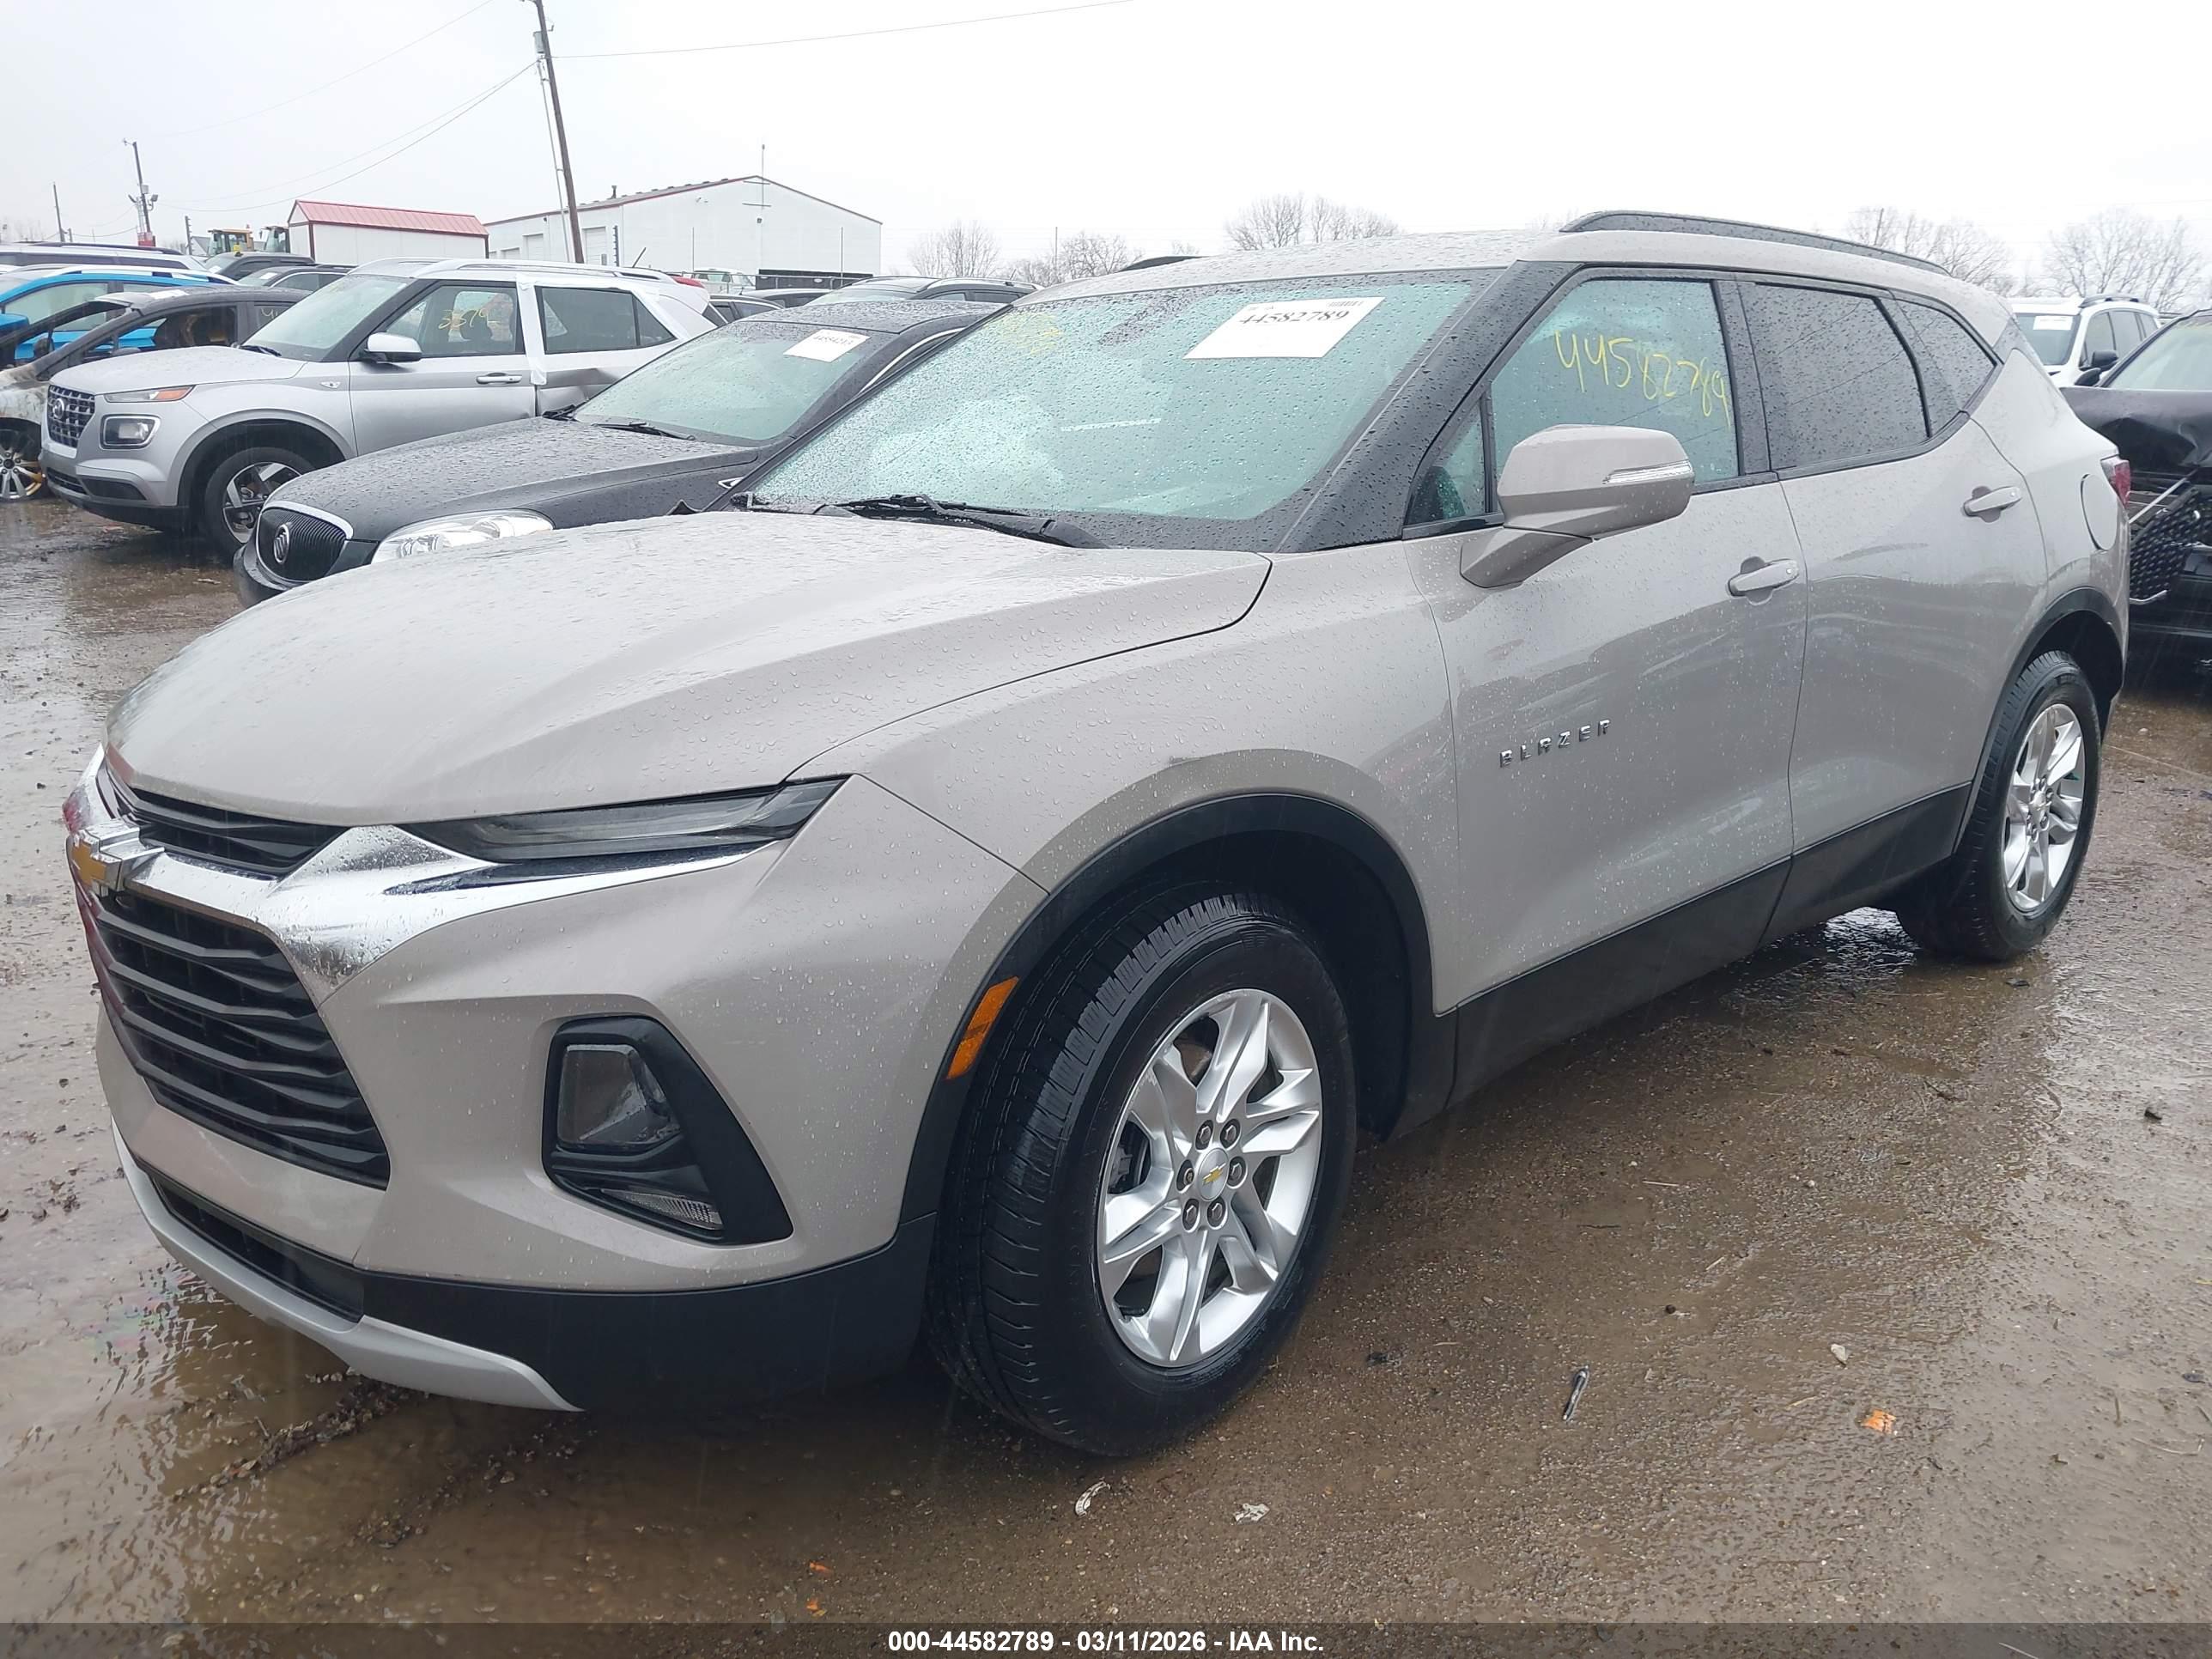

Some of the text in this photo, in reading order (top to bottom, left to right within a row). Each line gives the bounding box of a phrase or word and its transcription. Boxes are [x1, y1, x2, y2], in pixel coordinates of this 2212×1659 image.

[1239, 310, 1350, 325] 44582789
[1555, 330, 1731, 429] 44582789
[1499, 719, 1611, 769] BLAZER
